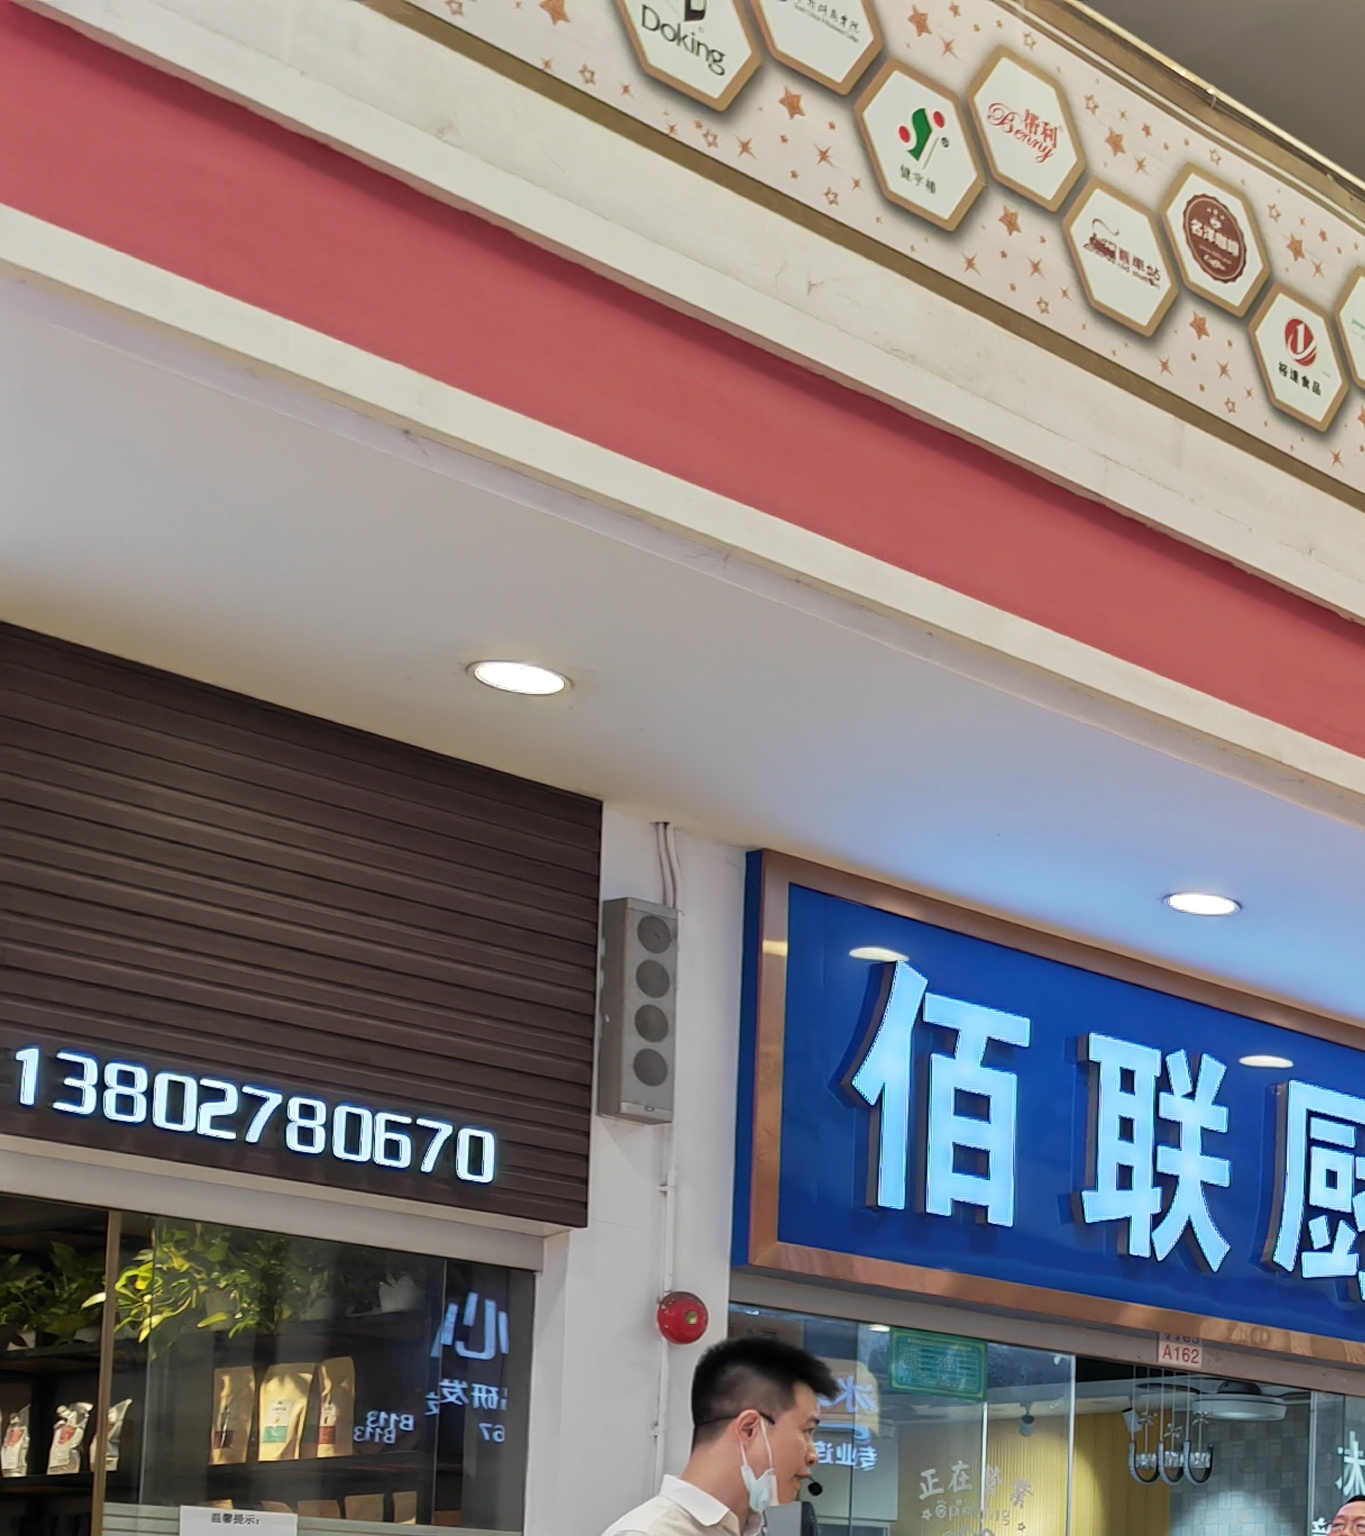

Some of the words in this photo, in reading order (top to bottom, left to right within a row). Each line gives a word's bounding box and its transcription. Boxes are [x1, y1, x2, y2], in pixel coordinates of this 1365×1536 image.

[641, 4, 726, 76] Doking
[986, 102, 1053, 163] Benny
[15, 1047, 496, 1183] 13802780670
[1162, 1344, 1200, 1364] A162
